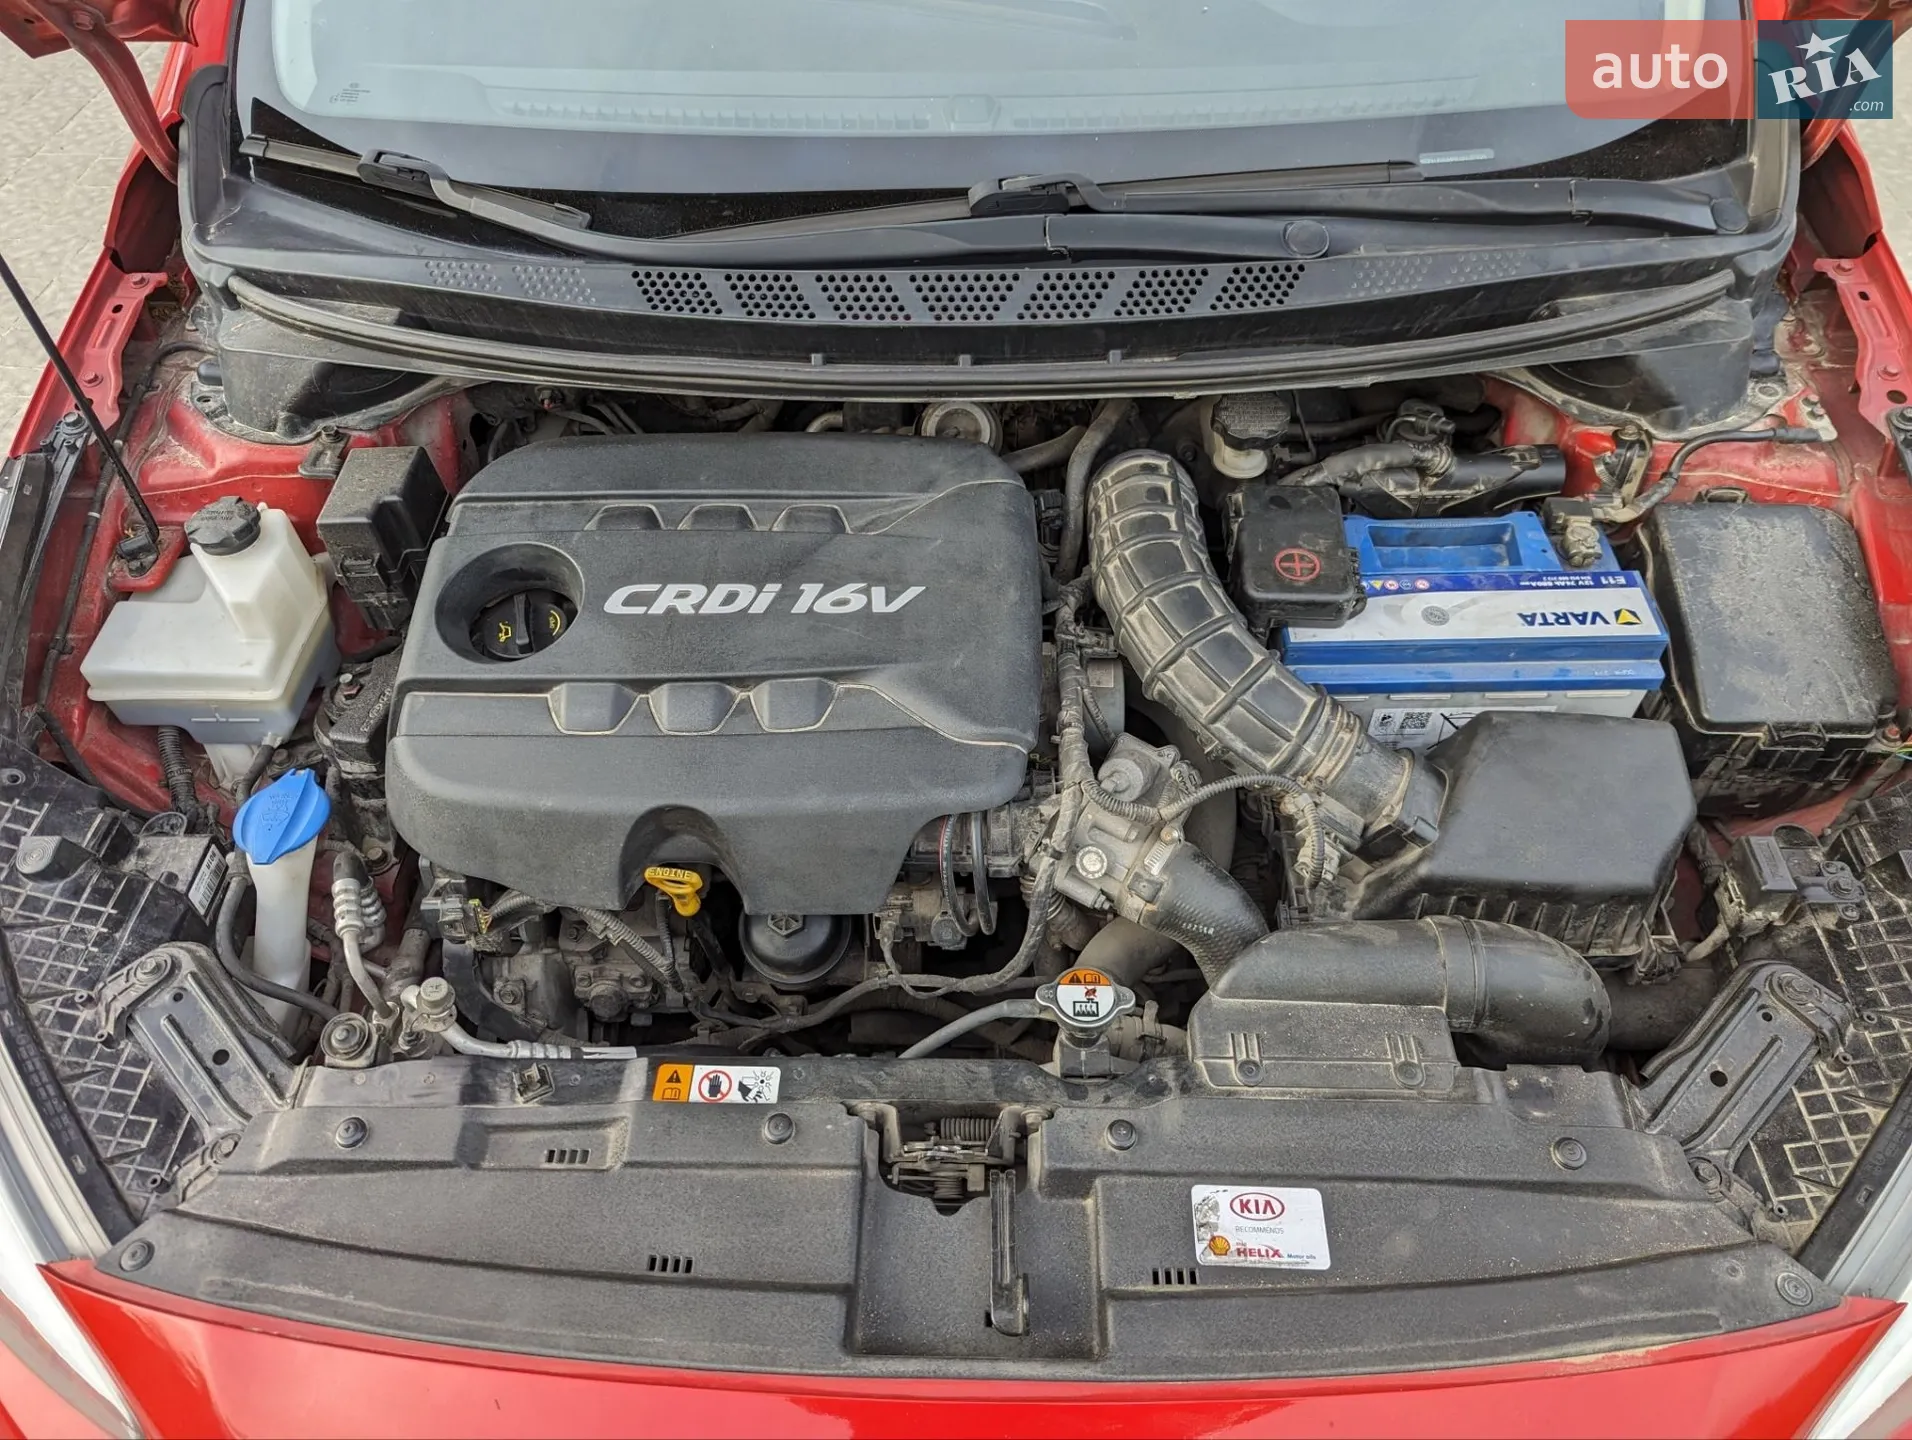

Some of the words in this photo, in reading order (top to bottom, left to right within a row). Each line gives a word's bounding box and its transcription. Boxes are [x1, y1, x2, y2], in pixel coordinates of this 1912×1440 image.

[1600, 575, 1627, 585] E11
[602, 583, 783, 615] CRDi
[790, 583, 926, 615] 16V
[1516, 610, 1611, 627] VARTA
[647, 867, 691, 880] ENGINE
[1238, 1198, 1277, 1215] KIA
[1235, 1225, 1285, 1235] RECOMMENDS
[1236, 1247, 1282, 1259] HELIX
